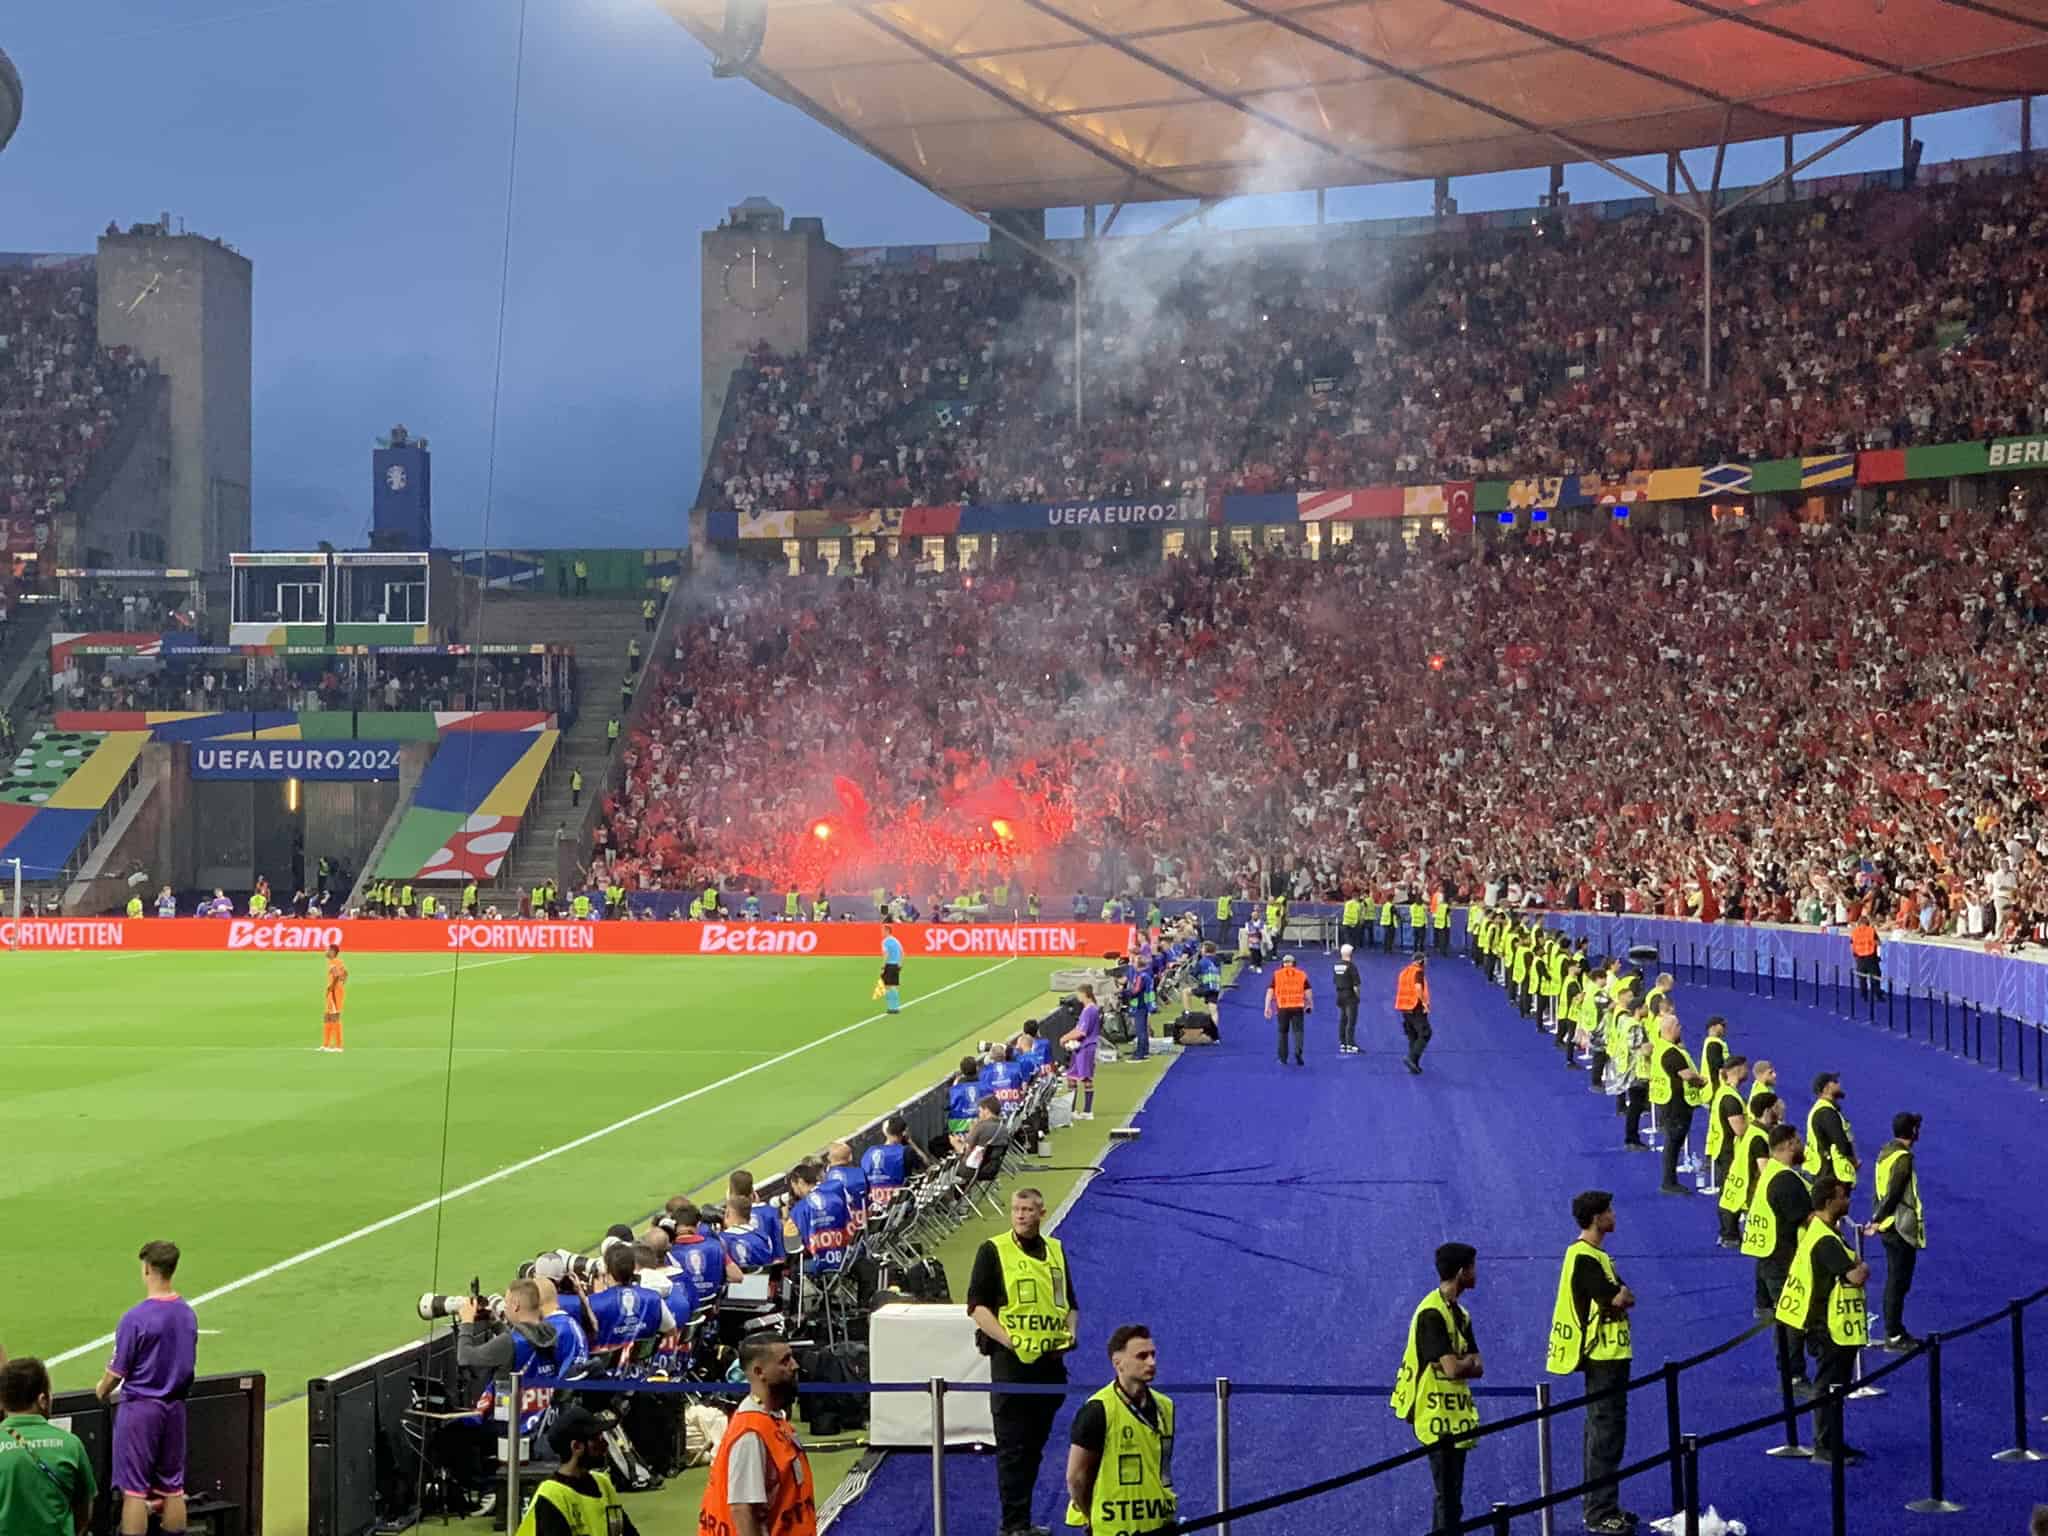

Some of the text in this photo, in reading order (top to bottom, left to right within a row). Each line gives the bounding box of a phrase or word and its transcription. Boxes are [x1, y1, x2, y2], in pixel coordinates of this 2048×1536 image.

[227, 921, 343, 948] Betano
[447, 924, 594, 949] SPORTWETTEN
[701, 925, 818, 953] Betano
[925, 927, 1076, 952] SPORTWETTEN
[522, 1388, 555, 1411] PH
